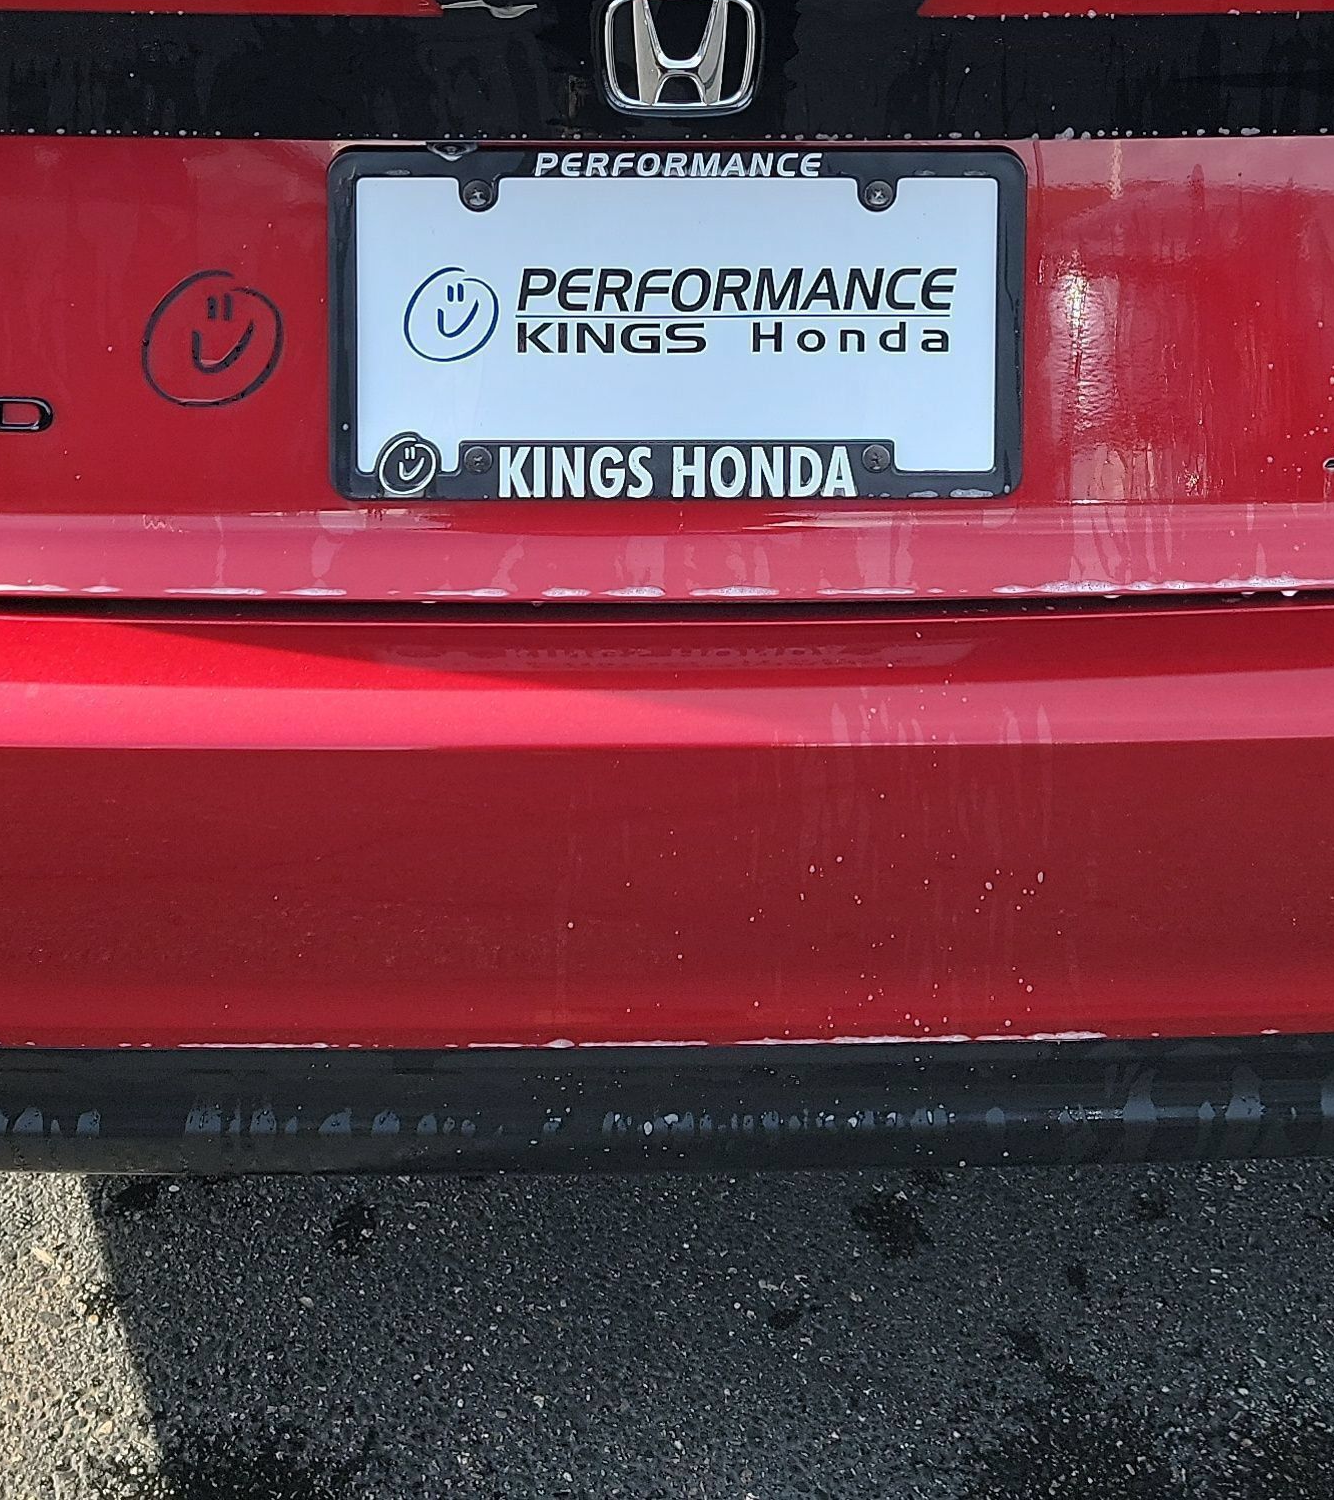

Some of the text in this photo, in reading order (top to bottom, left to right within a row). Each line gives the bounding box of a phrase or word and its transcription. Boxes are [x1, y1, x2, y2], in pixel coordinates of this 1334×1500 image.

[534, 151, 823, 178] PERFORMANCE
[515, 266, 959, 312] PERFORMANCE
[515, 321, 951, 355] KINGS Honda
[498, 445, 858, 499] KINGS HONDA
